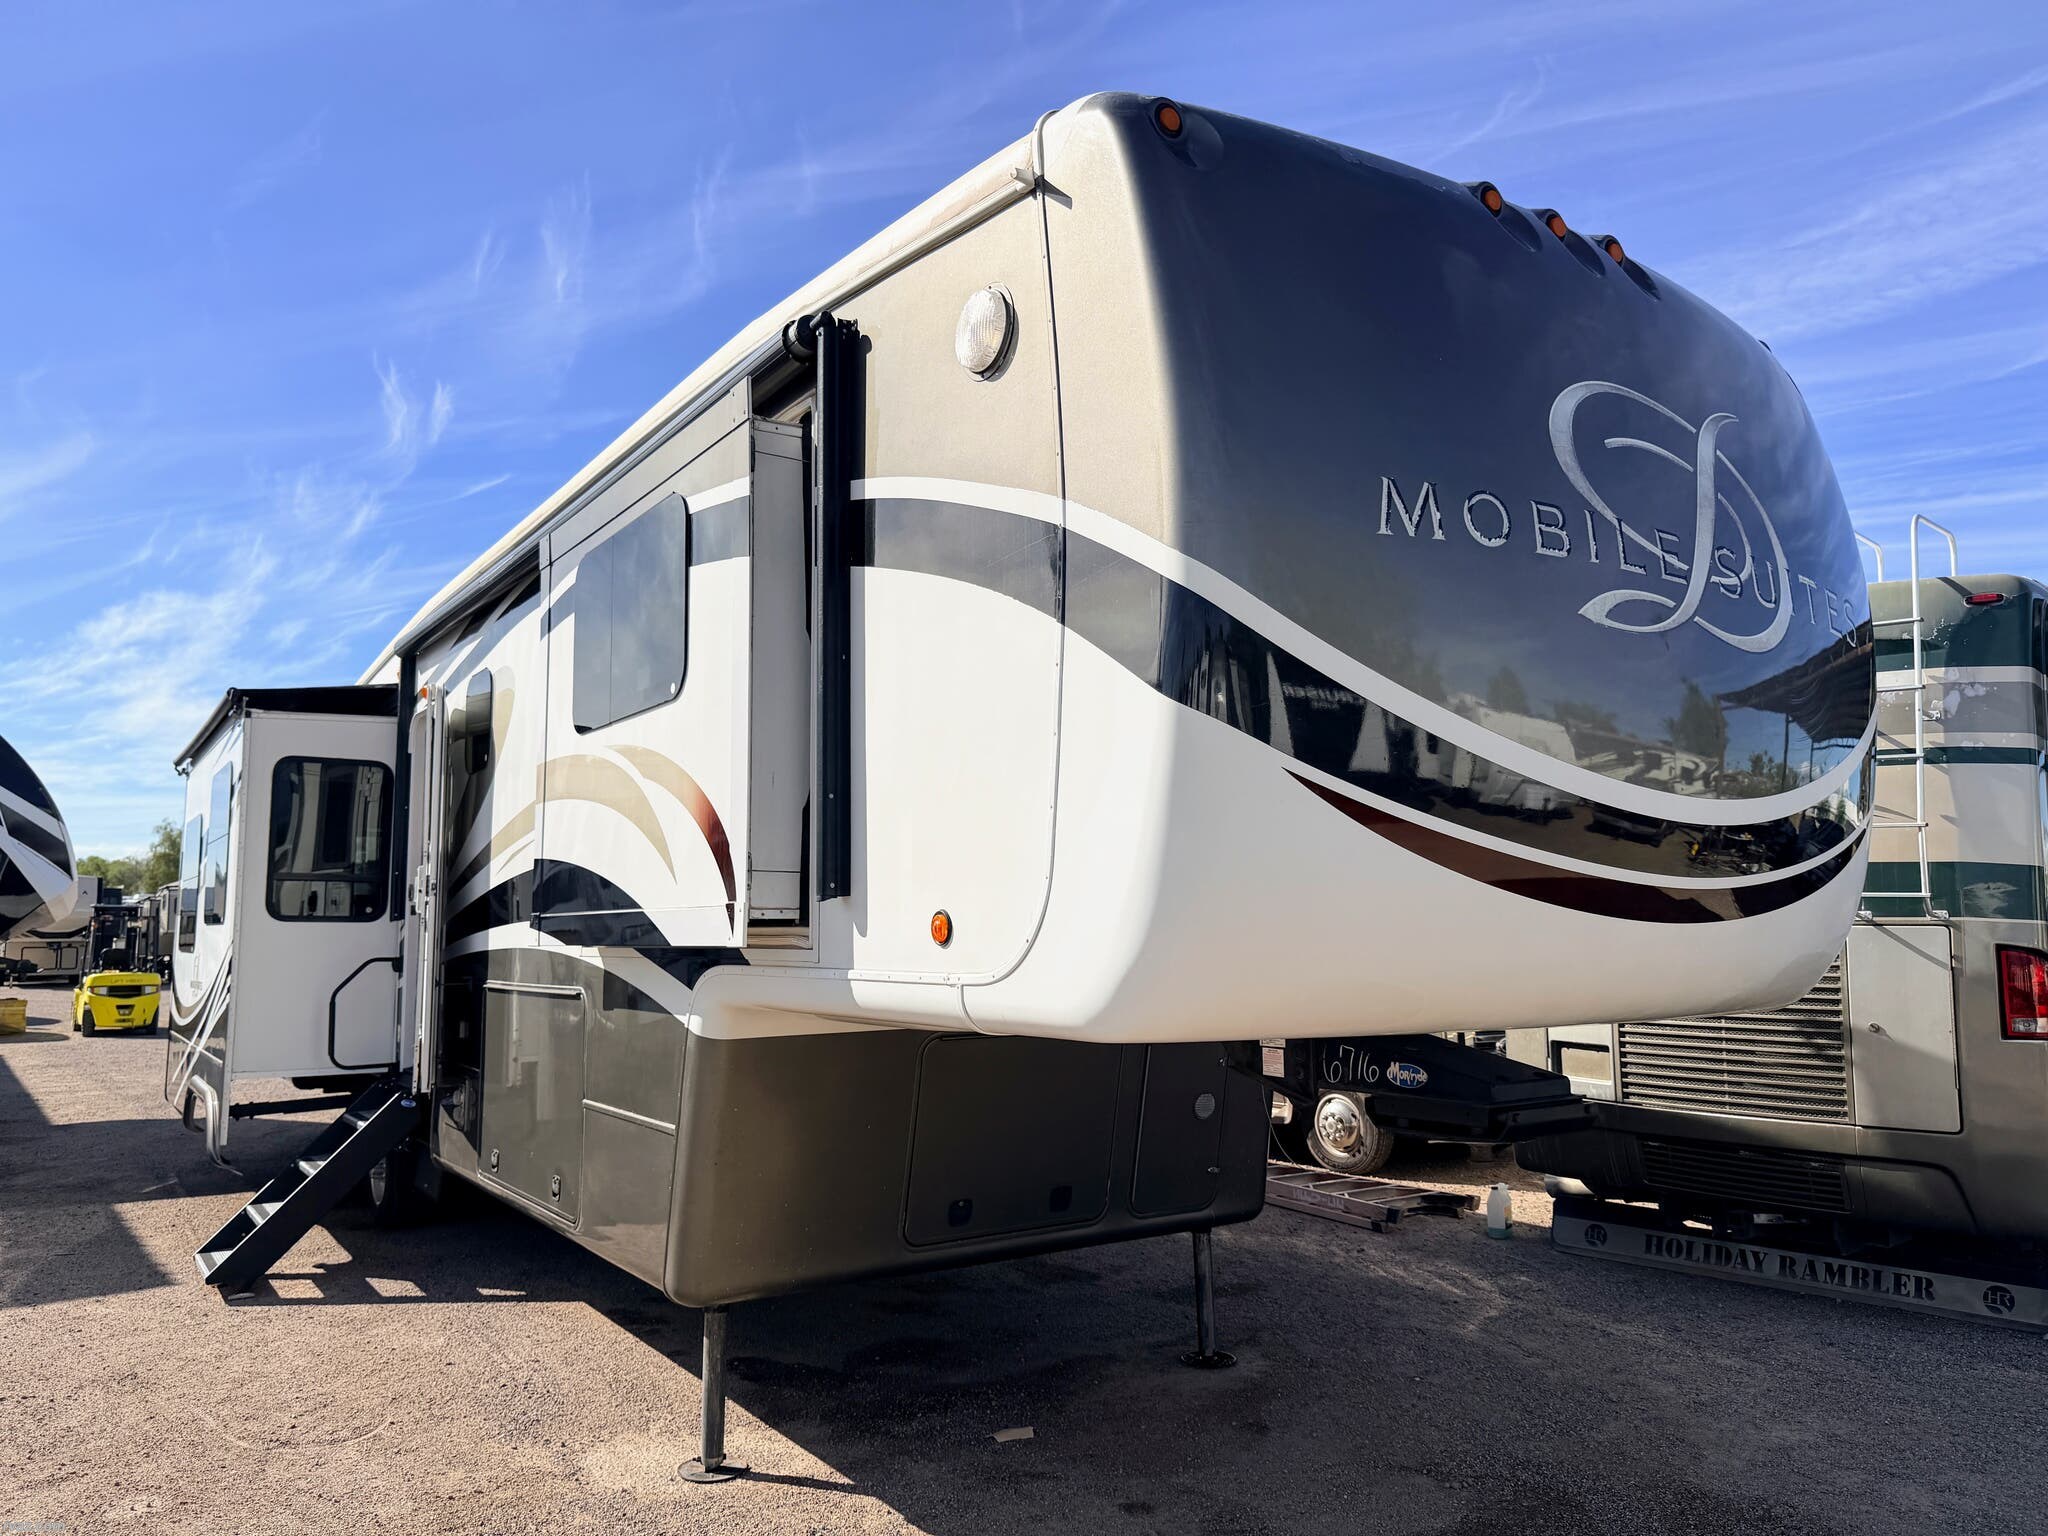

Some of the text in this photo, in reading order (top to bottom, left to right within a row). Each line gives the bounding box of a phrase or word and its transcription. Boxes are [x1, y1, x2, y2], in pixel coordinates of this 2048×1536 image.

[1376, 476, 1858, 648] MOBILE SUITES
[1323, 1043, 1380, 1083] 6716
[1644, 1233, 1936, 1301] HOLIDAY RAMBLER
